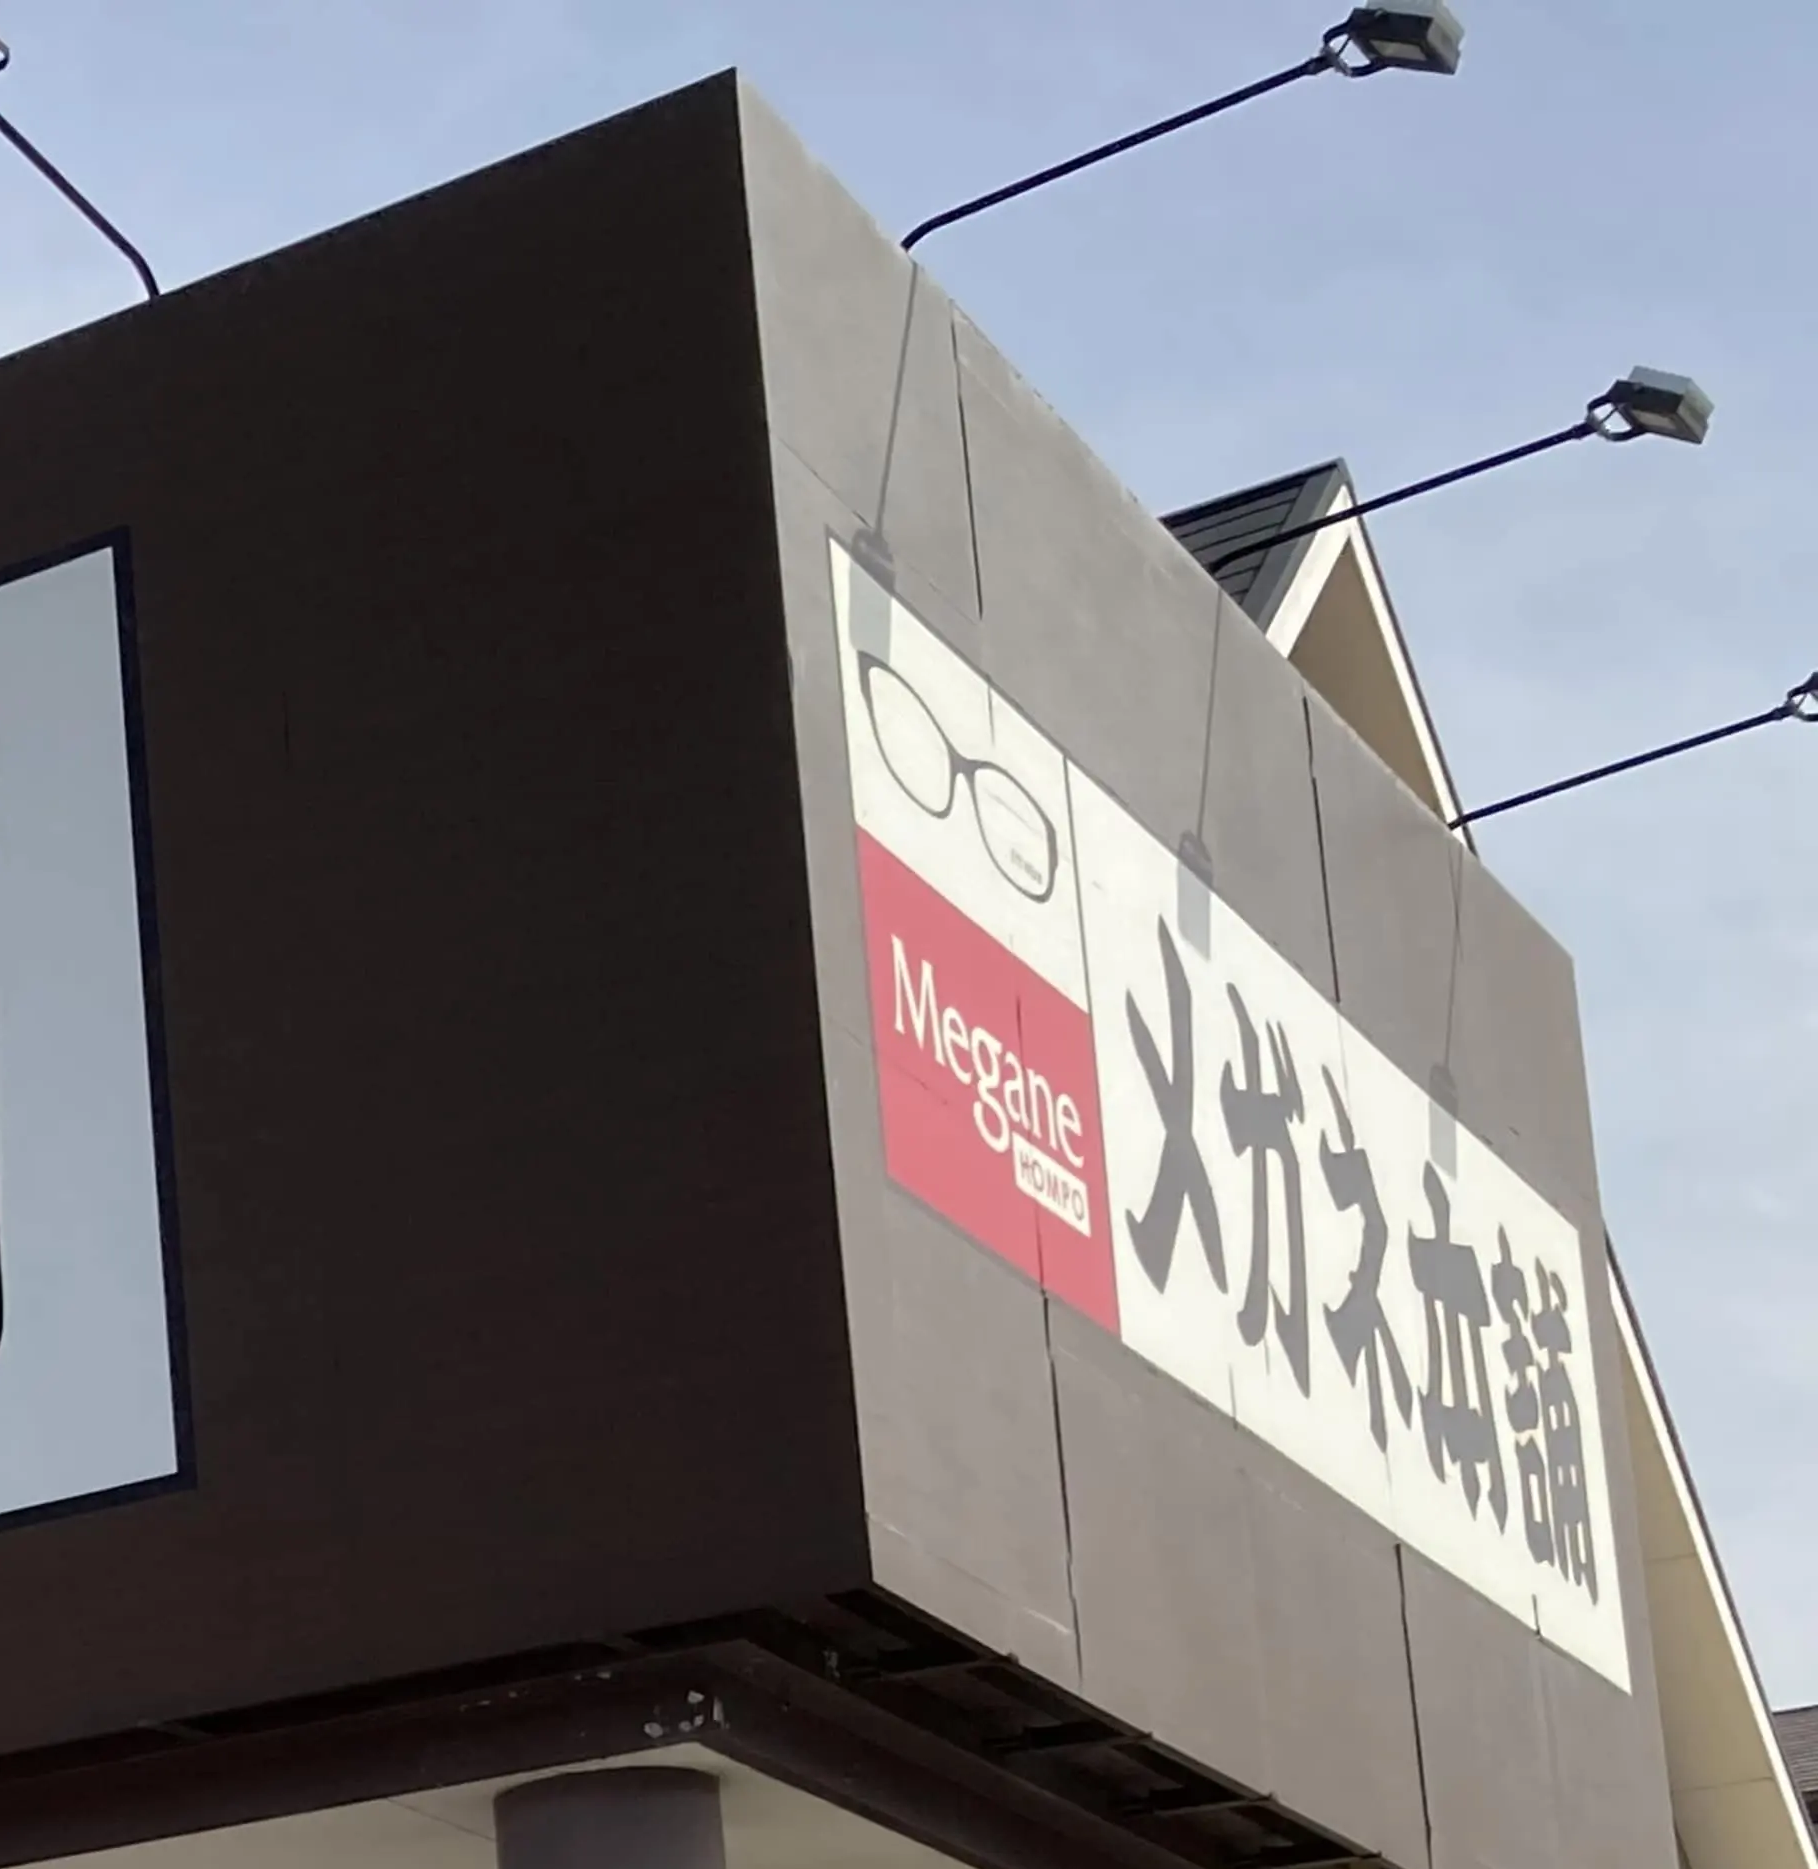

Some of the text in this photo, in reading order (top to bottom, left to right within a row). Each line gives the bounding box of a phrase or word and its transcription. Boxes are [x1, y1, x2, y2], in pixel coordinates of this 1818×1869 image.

[890, 934, 1083, 1153] Megane
[1017, 1140, 1088, 1224] HOMPO
[1124, 914, 1598, 1606] メガネ本舗
